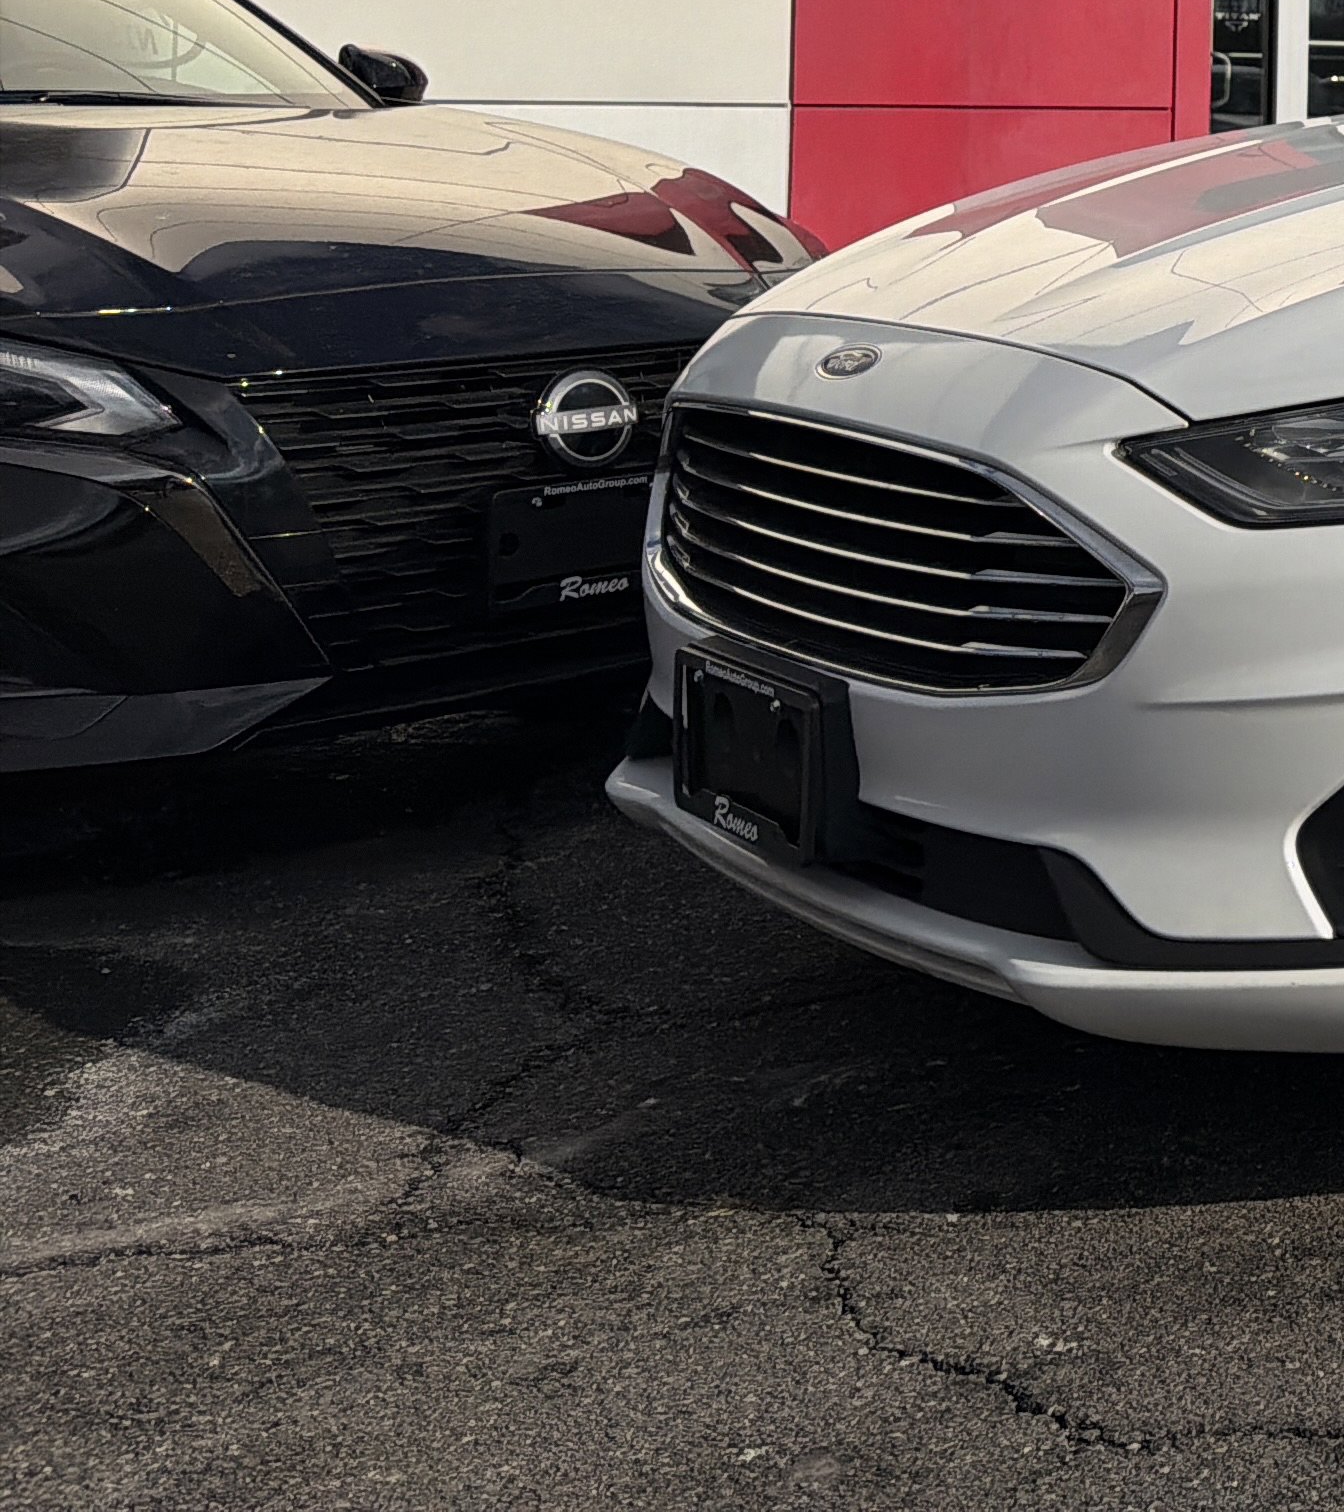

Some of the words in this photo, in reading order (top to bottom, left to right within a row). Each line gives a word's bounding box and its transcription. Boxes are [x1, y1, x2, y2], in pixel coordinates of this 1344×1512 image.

[540, 407, 637, 432] NISSAN
[544, 476, 648, 496] RomeoAutoGroup.com
[560, 575, 630, 602] Romeo
[713, 795, 759, 842] Romeo
